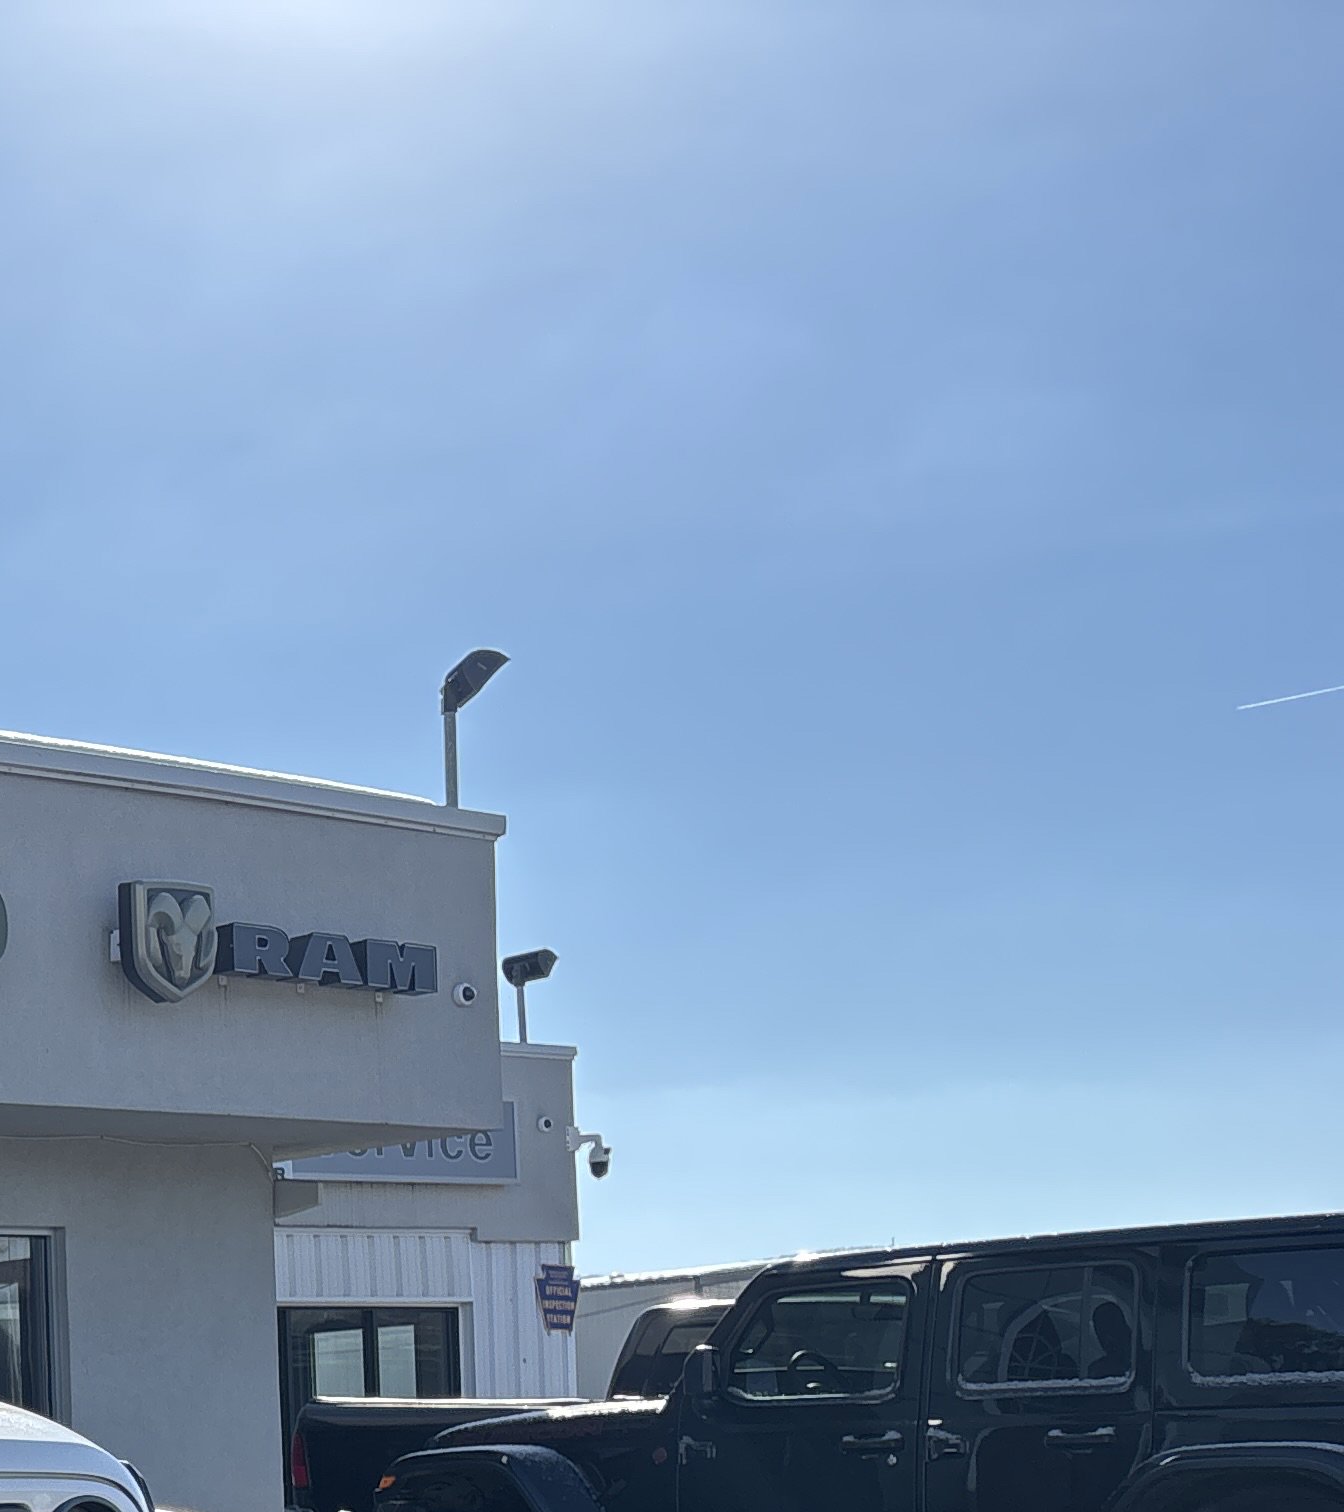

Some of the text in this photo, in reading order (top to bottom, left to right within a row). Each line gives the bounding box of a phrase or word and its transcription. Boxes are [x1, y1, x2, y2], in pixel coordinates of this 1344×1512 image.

[214, 921, 439, 996] RAM
[545, 1285, 572, 1297] OFFICIAL
[546, 1313, 571, 1324] STATION
